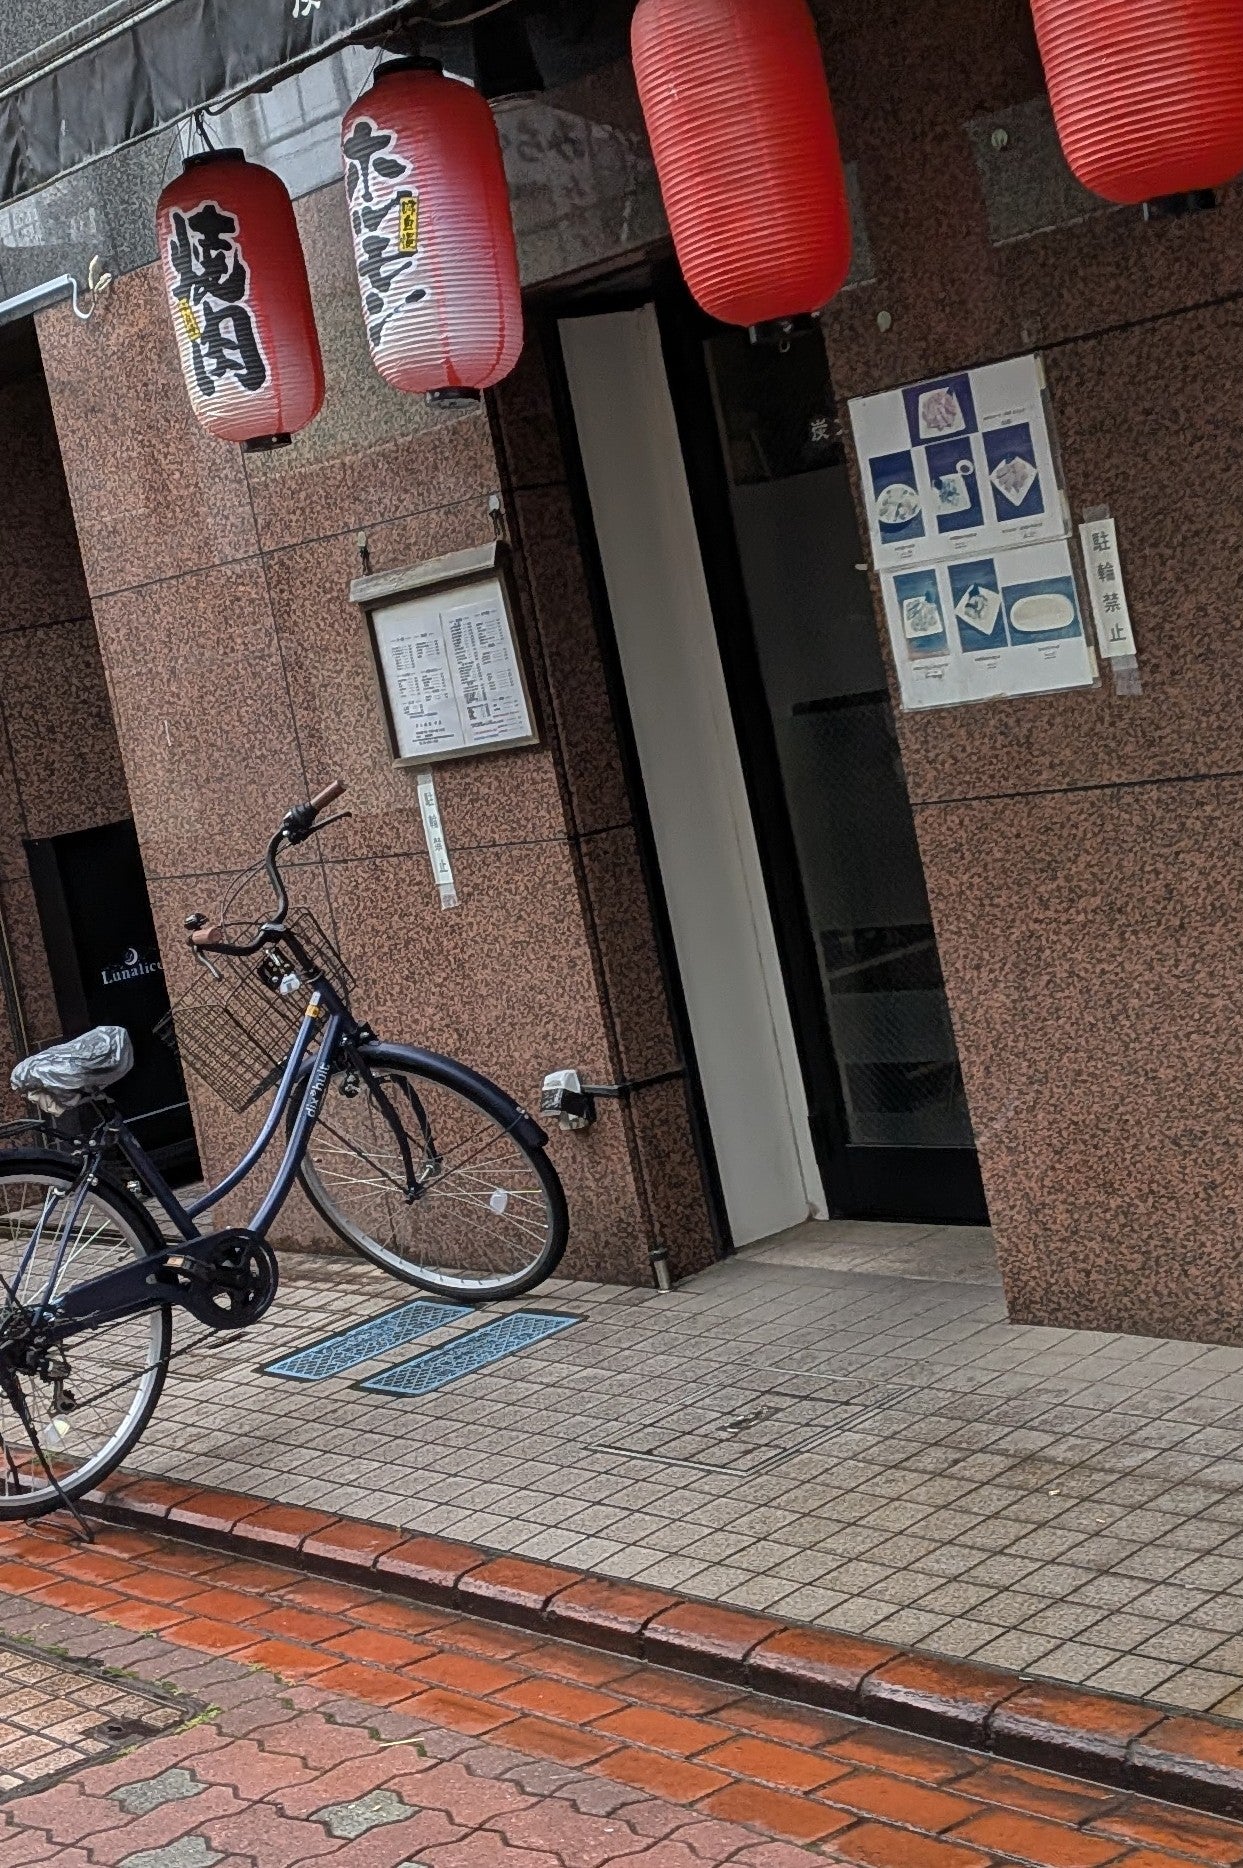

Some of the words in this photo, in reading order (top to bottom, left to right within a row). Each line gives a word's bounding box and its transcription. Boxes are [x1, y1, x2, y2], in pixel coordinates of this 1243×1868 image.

[172, 205, 266, 396] 焼肉
[344, 121, 427, 346] ホルモン
[1092, 531, 1127, 642] 駐輪禁止
